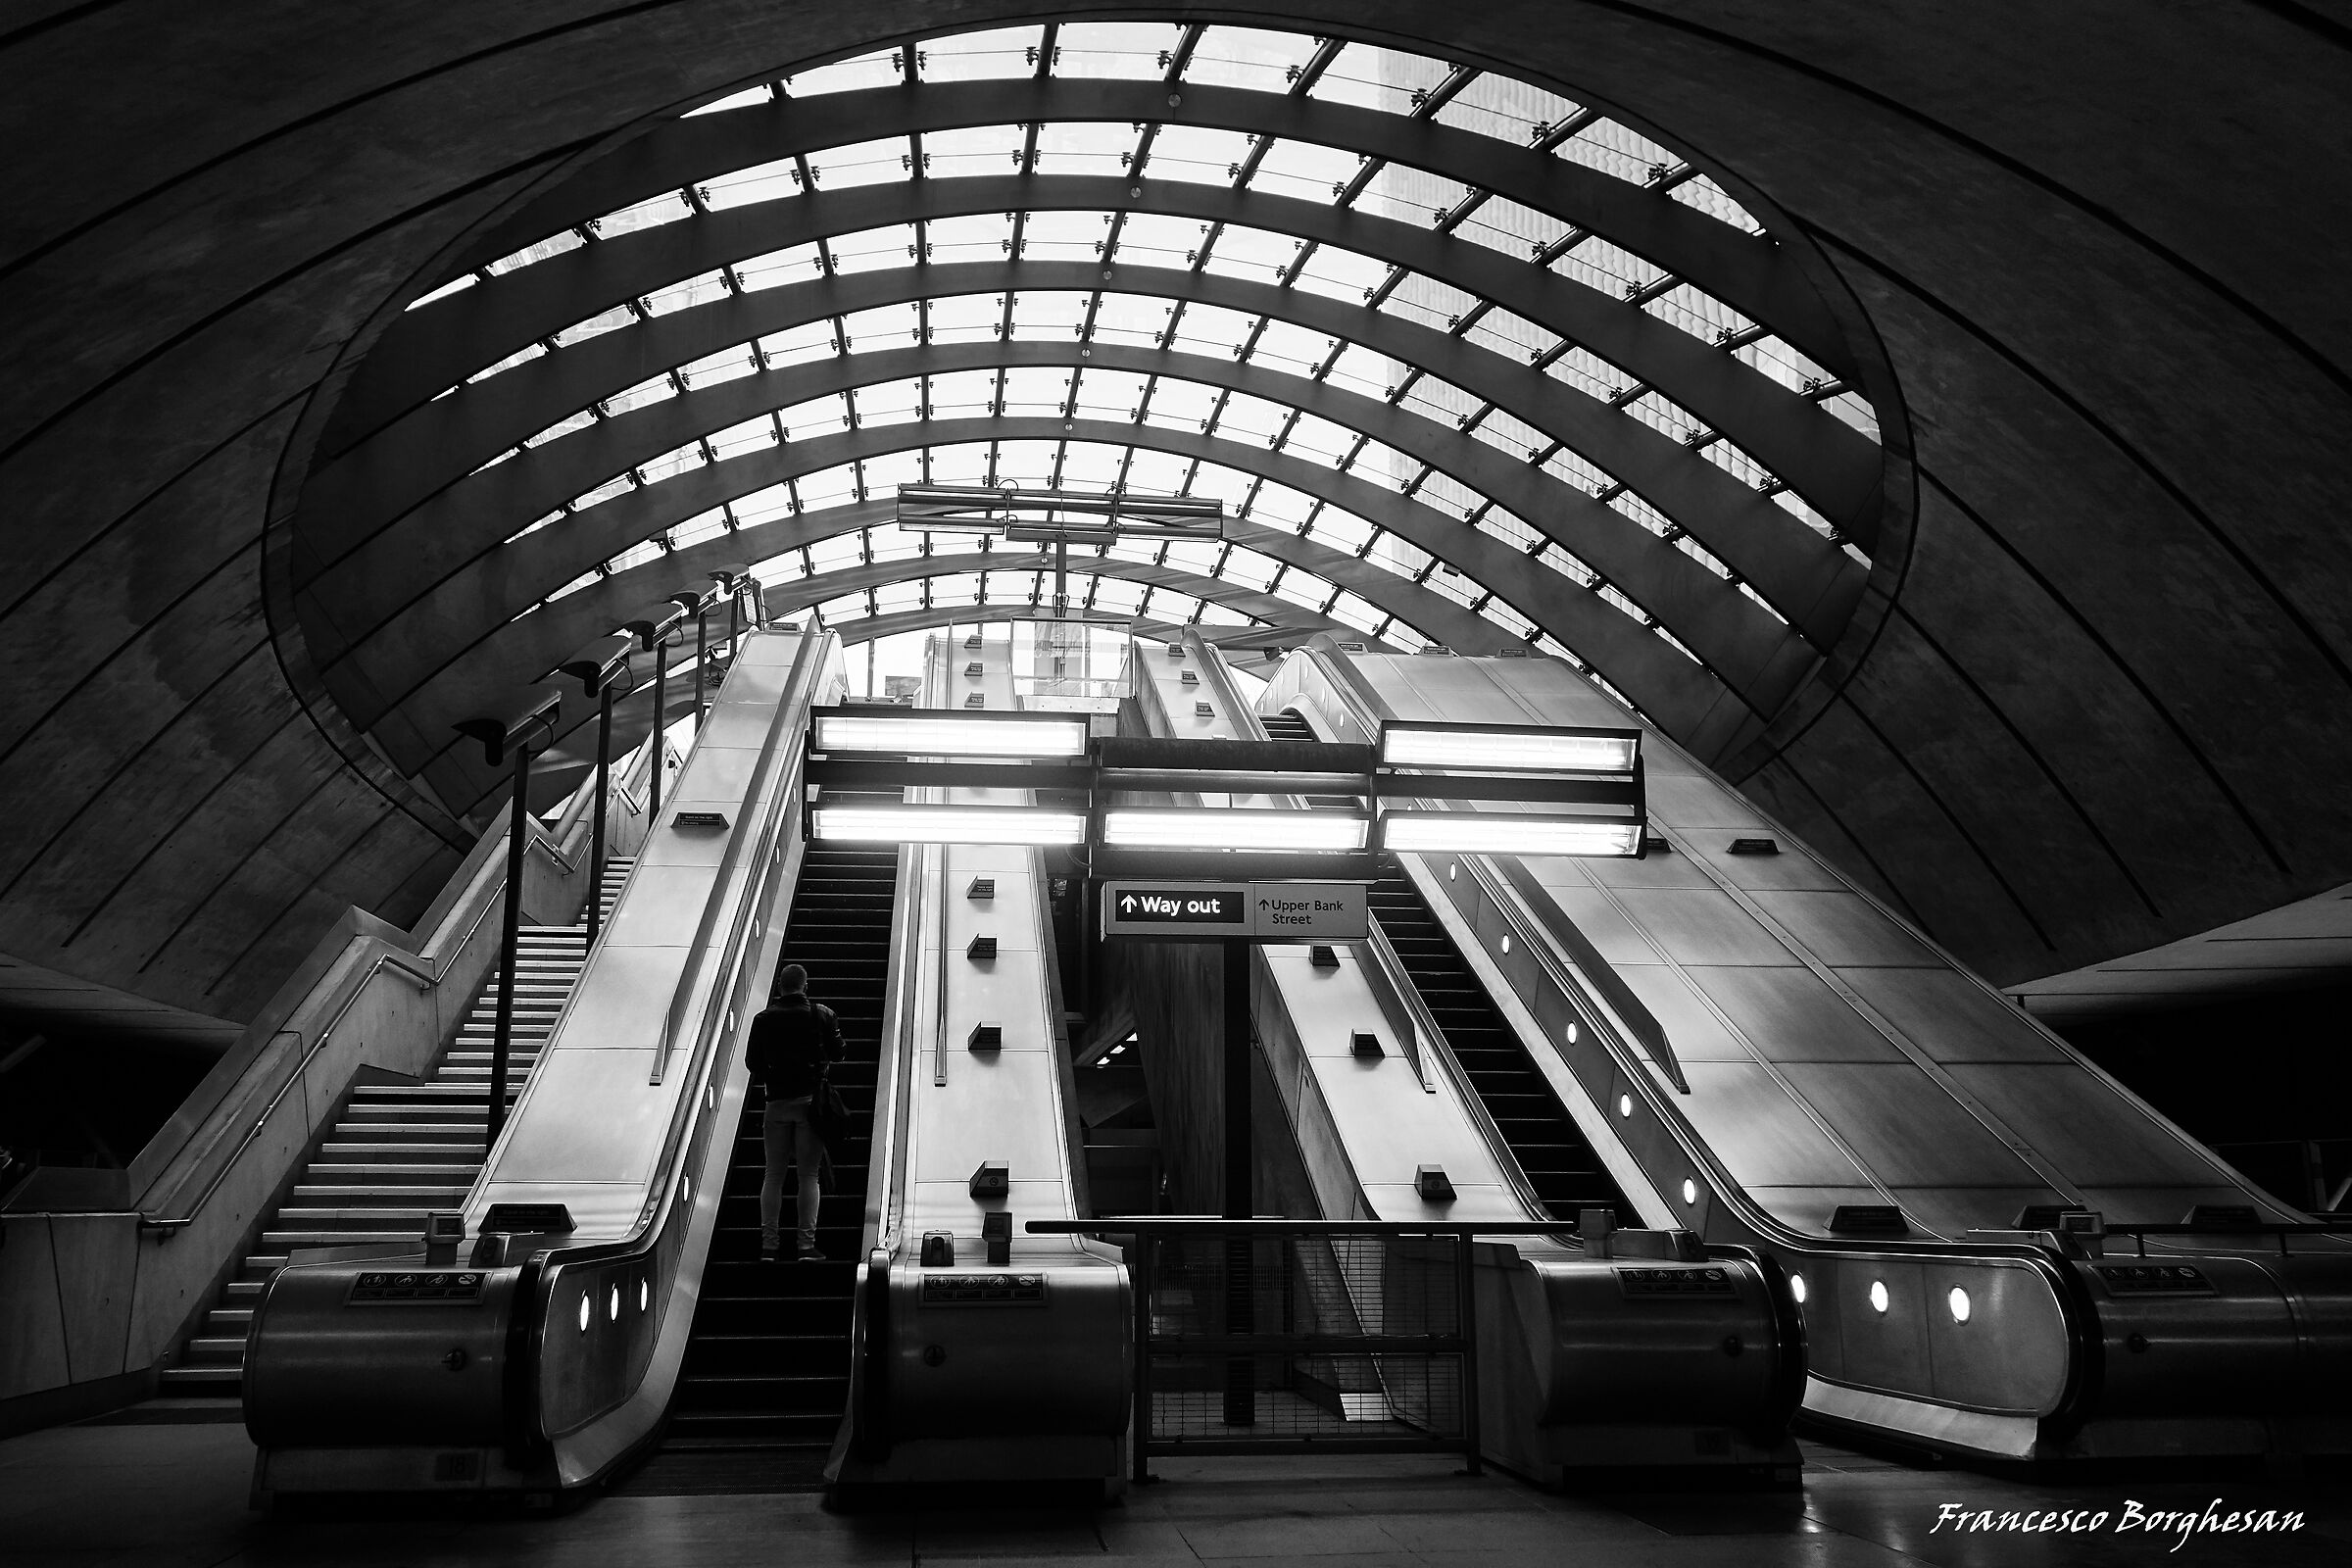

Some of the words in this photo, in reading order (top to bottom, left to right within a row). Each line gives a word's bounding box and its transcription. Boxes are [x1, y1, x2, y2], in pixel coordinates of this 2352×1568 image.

[1140, 896, 1182, 917] Way
[1187, 898, 1221, 914] out
[1271, 899, 1310, 913] Upper
[1314, 900, 1344, 911] Bank
[1272, 912, 1312, 925] Street
